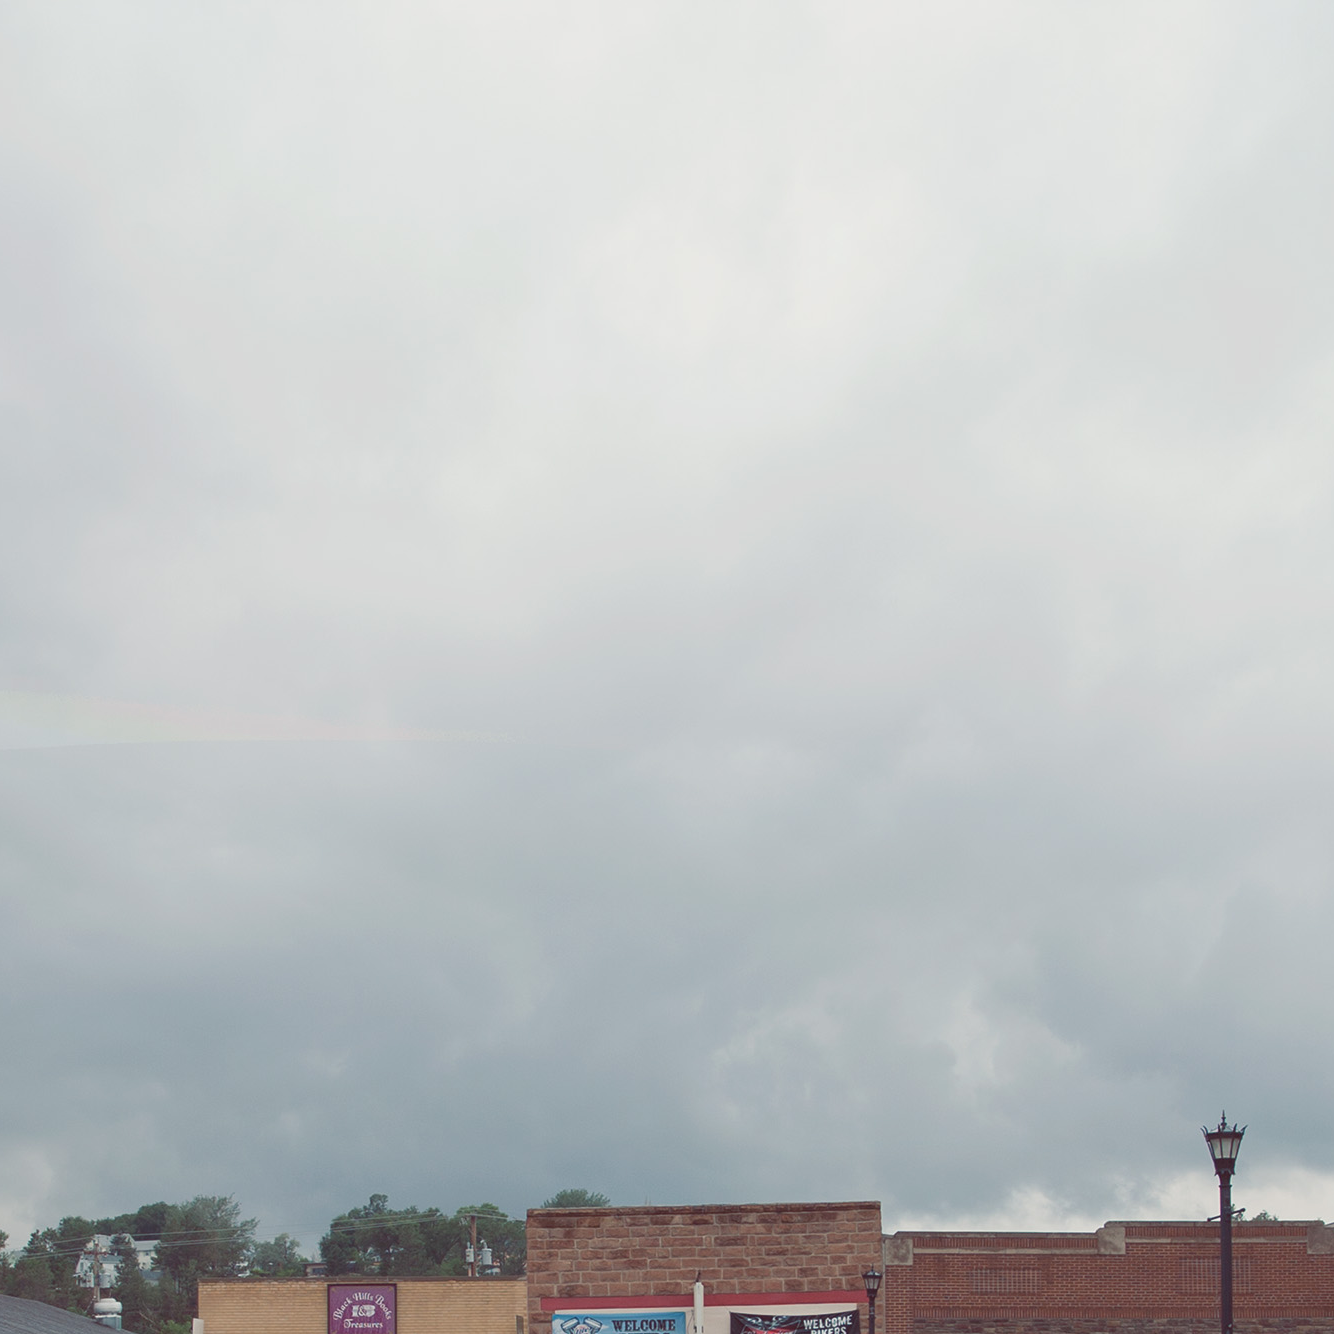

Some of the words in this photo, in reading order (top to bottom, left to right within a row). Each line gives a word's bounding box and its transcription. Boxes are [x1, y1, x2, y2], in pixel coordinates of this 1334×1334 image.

[333, 1297, 353, 1320] Black
[352, 1292, 374, 1301] Hills
[375, 1294, 392, 1320] Books
[343, 1318, 384, 1328] Treasures
[611, 1319, 676, 1332] WELCOME
[803, 1314, 853, 1330] WELCOME
